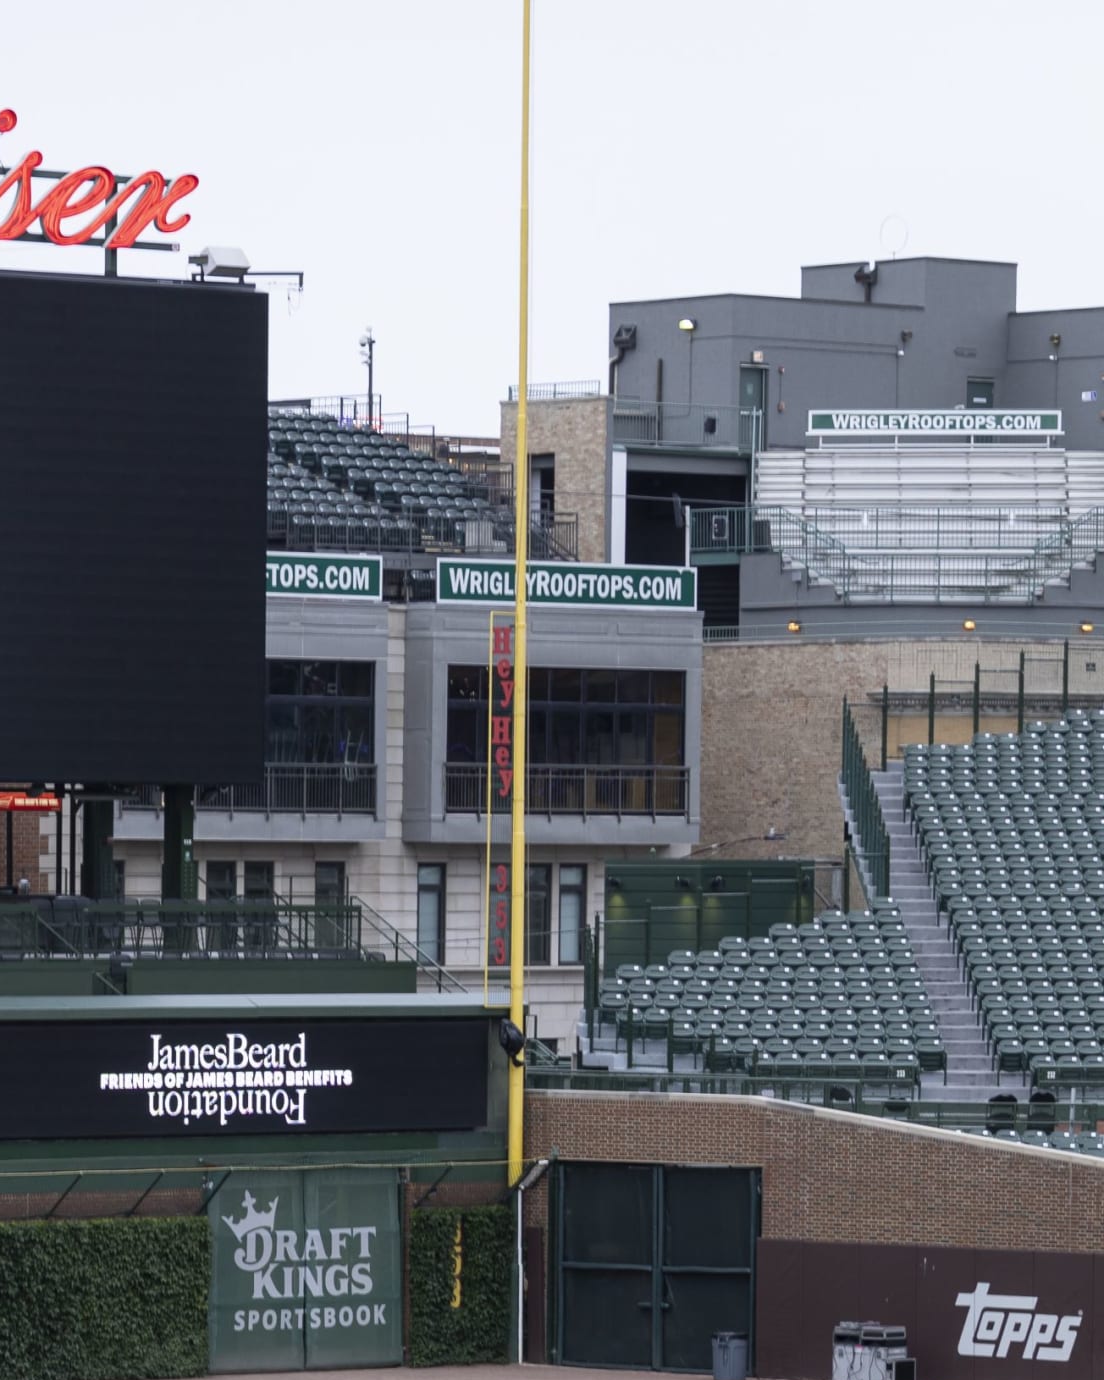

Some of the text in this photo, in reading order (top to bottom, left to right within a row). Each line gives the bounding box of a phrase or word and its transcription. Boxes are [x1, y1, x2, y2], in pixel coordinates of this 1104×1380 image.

[449, 568, 682, 600] WRIGLYROOFTOPS.COM
[491, 627, 515, 797] Hey Hey
[495, 865, 508, 965] 353
[100, 1070, 353, 1089] FRIENDS OF JAMES BEARD BENEFITS
[234, 1226, 376, 1271] DRAFT
[252, 1262, 373, 1299] KINGS
[234, 1304, 386, 1331] SPORTSBOOK
